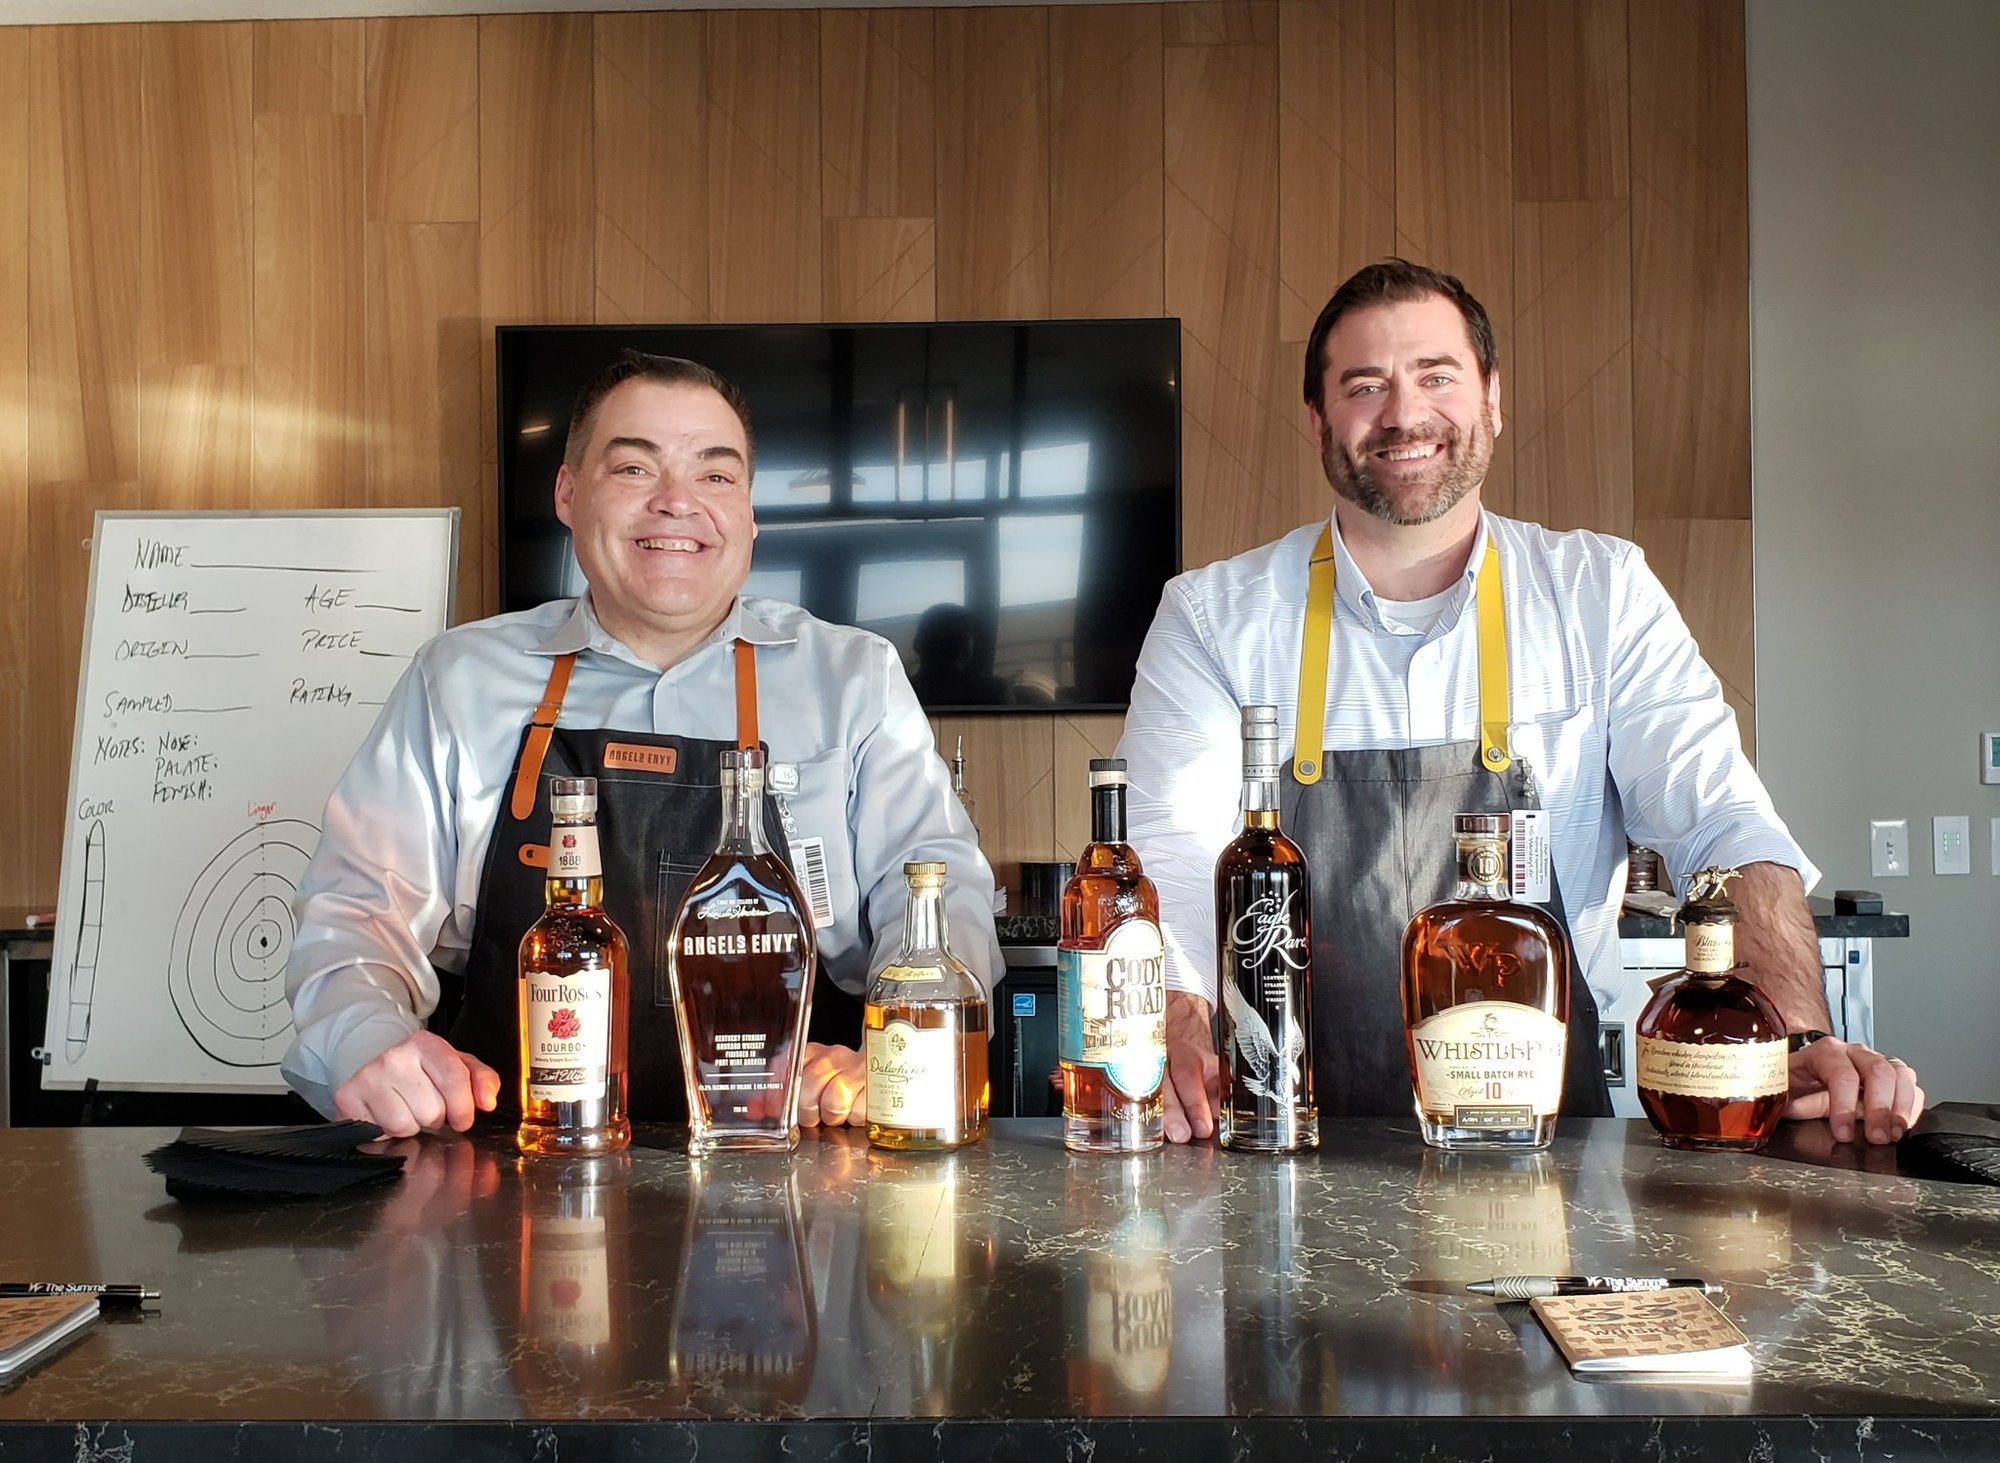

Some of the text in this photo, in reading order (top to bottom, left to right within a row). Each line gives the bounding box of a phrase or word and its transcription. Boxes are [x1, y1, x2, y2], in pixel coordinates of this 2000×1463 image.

[135, 538, 190, 569] NAME
[304, 584, 356, 613] AGE
[115, 639, 188, 661] ORIGIN
[302, 629, 363, 652] PRICE
[290, 678, 352, 707] RATING
[104, 690, 173, 718] SAMPLED
[155, 753, 218, 780] PALATE:
[609, 750, 672, 765] ANGELS ENVY
[78, 798, 115, 820] COLOR
[559, 856, 581, 866] 1888
[1478, 858, 1496, 873] 10
[1232, 889, 1298, 953] Eagle
[684, 933, 794, 956] ANGELS ENVY
[1106, 955, 1163, 989] CODY
[531, 983, 557, 1002] Four
[1105, 986, 1164, 1020] ROAD
[541, 1043, 586, 1052] BOURBO
[1484, 1070, 1514, 1079] BATCH
[1517, 1070, 1534, 1078] RYE
[1485, 1082, 1501, 1099] 10
[891, 1097, 904, 1108] 15
[45, 1283, 65, 1292] The
[1603, 1276, 1625, 1286] The
[1588, 1323, 1689, 1337] WHISKEY
